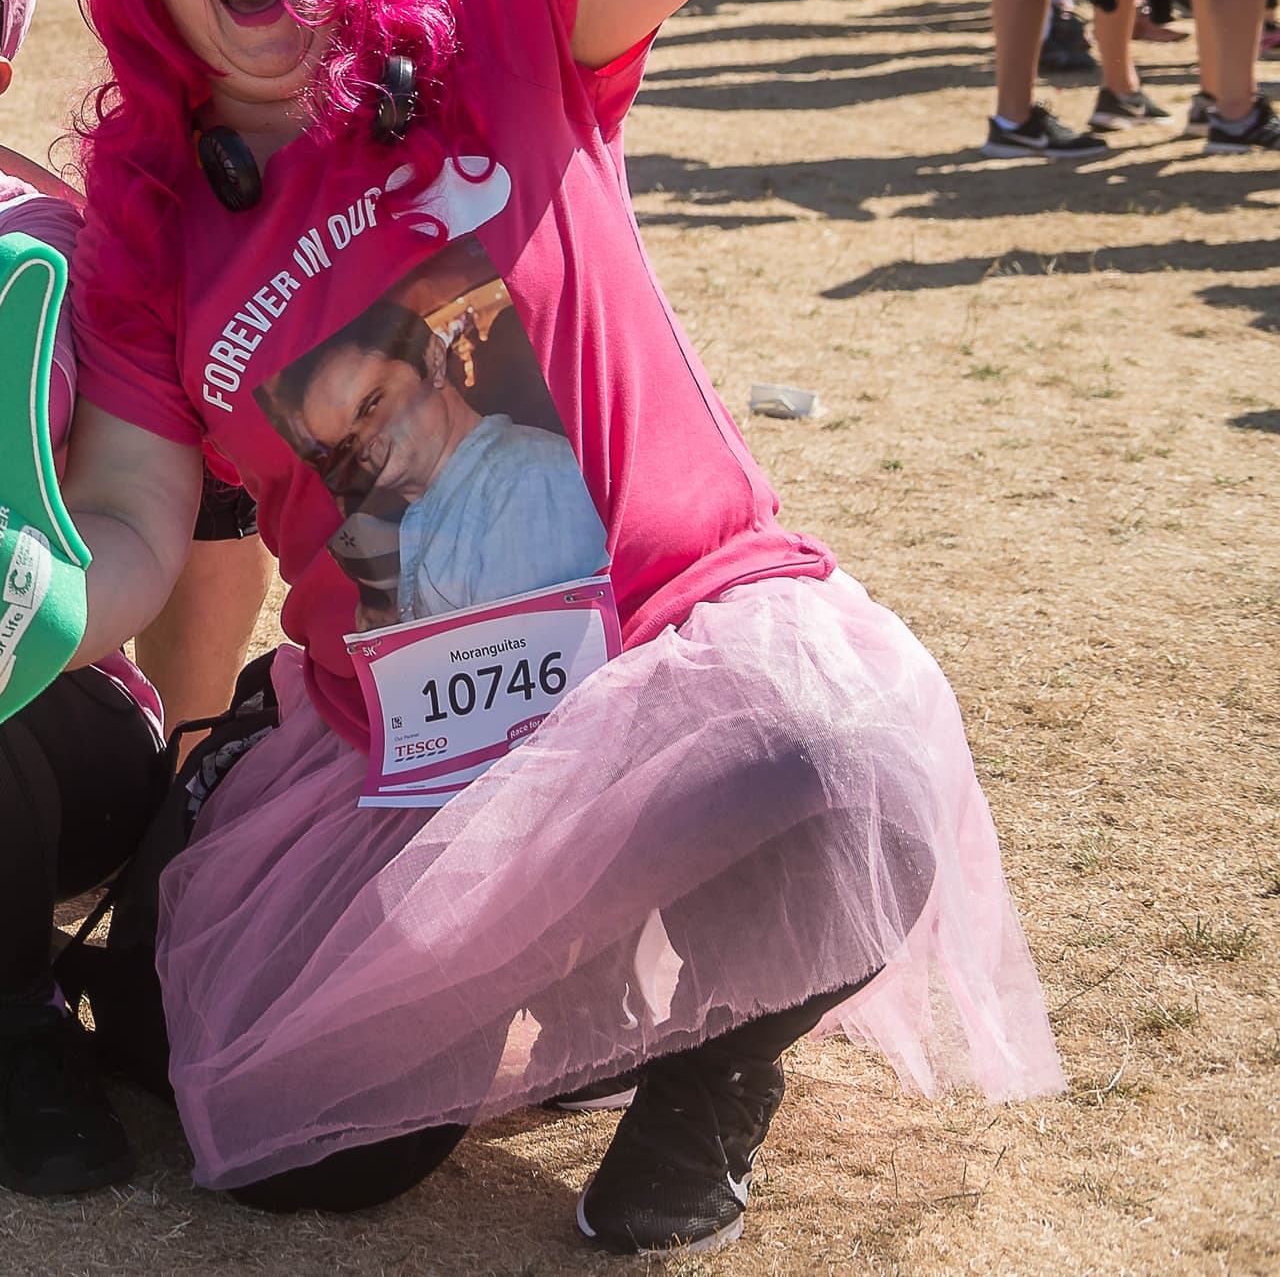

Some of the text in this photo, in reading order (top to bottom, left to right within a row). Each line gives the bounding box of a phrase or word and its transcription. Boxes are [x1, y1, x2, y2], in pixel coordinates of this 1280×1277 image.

[202, 270, 301, 413] FOREVER
[292, 227, 333, 278] IN
[2, 612, 24, 639] Life
[449, 637, 527, 664] Moranguitas
[421, 651, 567, 723] 10746
[510, 725, 528, 739] Race
[395, 737, 448, 757] TESCO
